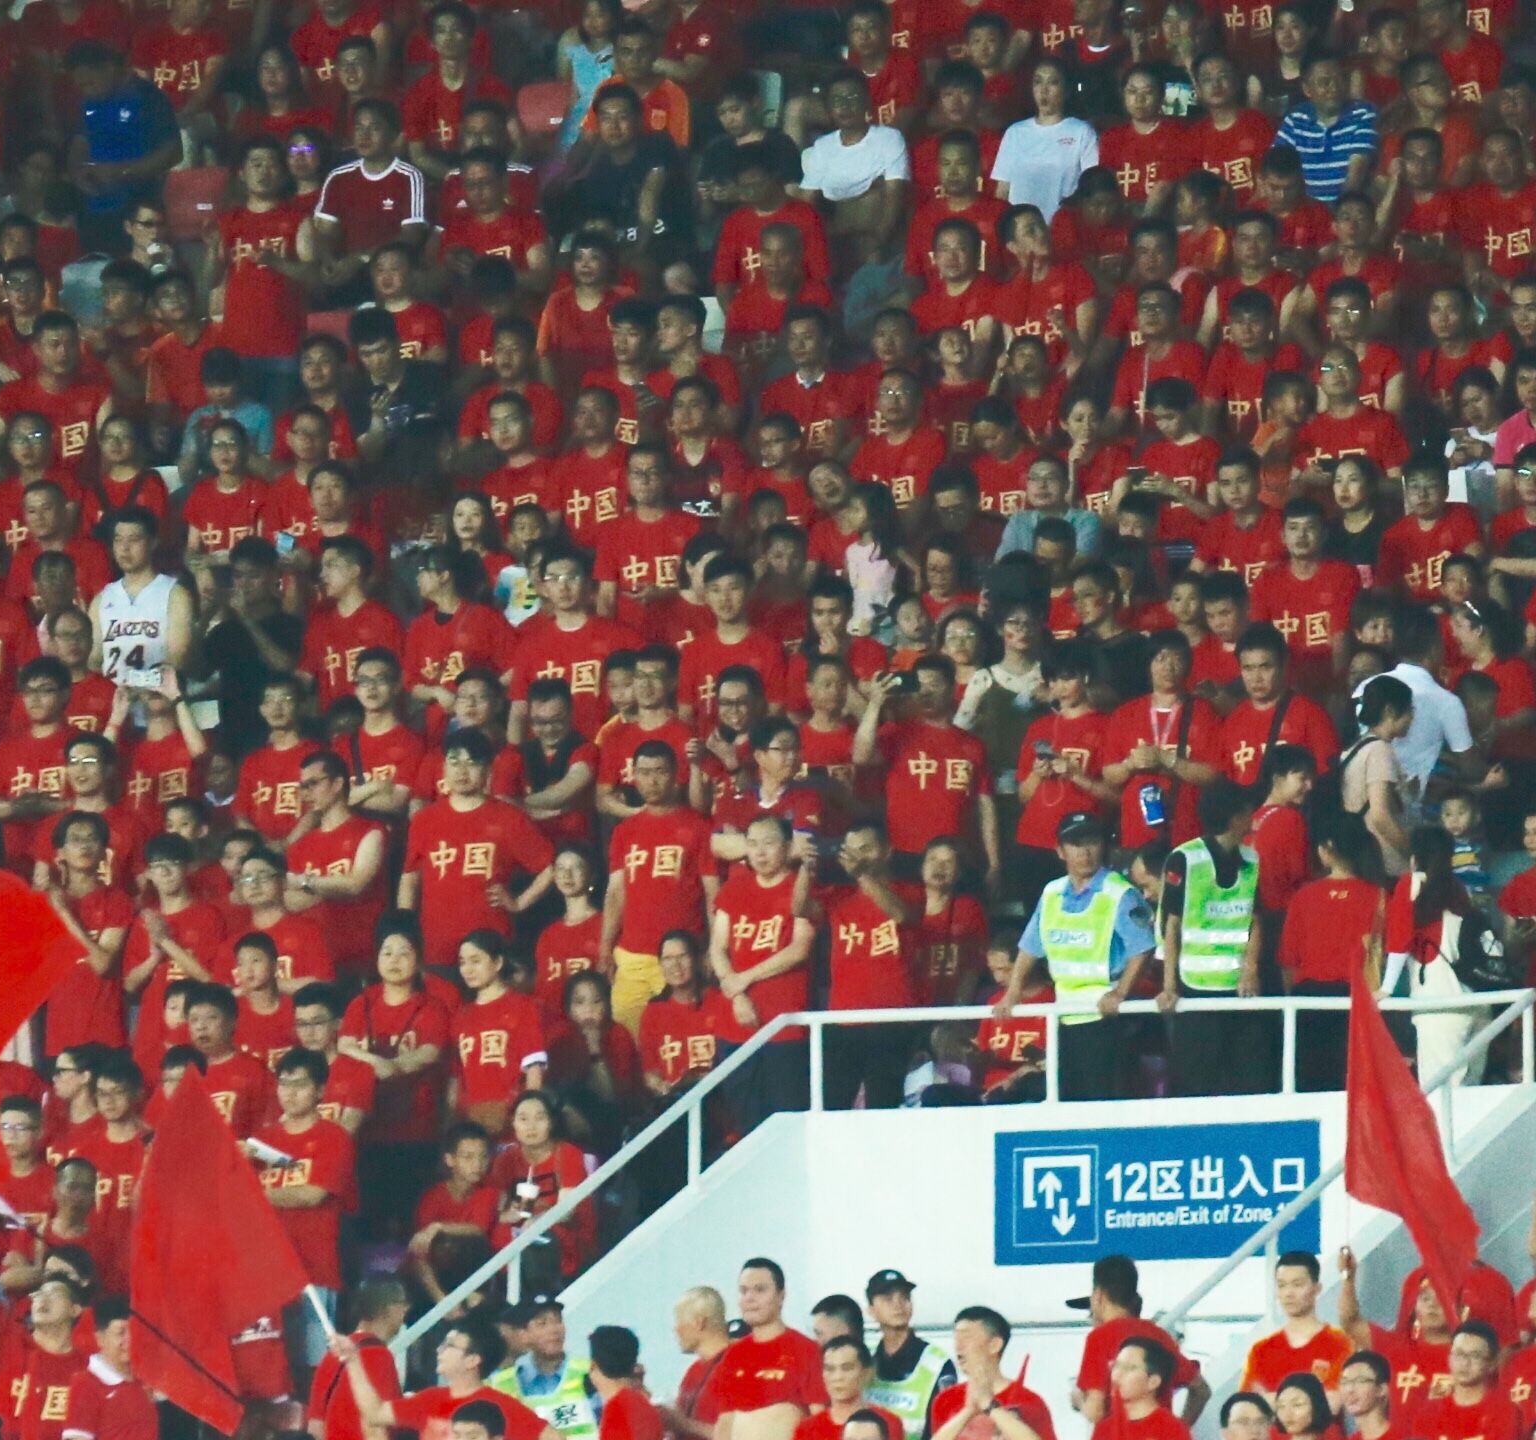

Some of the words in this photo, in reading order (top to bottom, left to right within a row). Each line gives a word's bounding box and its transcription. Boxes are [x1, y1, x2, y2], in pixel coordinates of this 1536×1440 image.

[1485, 228, 1530, 264] 中国
[567, 488, 618, 526] 中国
[622, 554, 680, 592] 中国
[103, 620, 160, 642] LAKERS
[1273, 611, 1332, 647] 中国
[106, 645, 145, 678] 24
[129, 767, 187, 809] 中国
[909, 751, 969, 790] 中国
[253, 776, 303, 817] 中国
[430, 840, 495, 879] 中国
[625, 843, 683, 884] 中国
[733, 914, 782, 952] 中国
[459, 1029, 508, 1068] 中国
[660, 1036, 715, 1076] 中国
[1105, 1155, 1305, 1202] 12区出入口
[1105, 1206, 1209, 1228] Entrance/Exit
[1213, 1205, 1230, 1224] of
[1233, 1204, 1273, 1223] Zone
